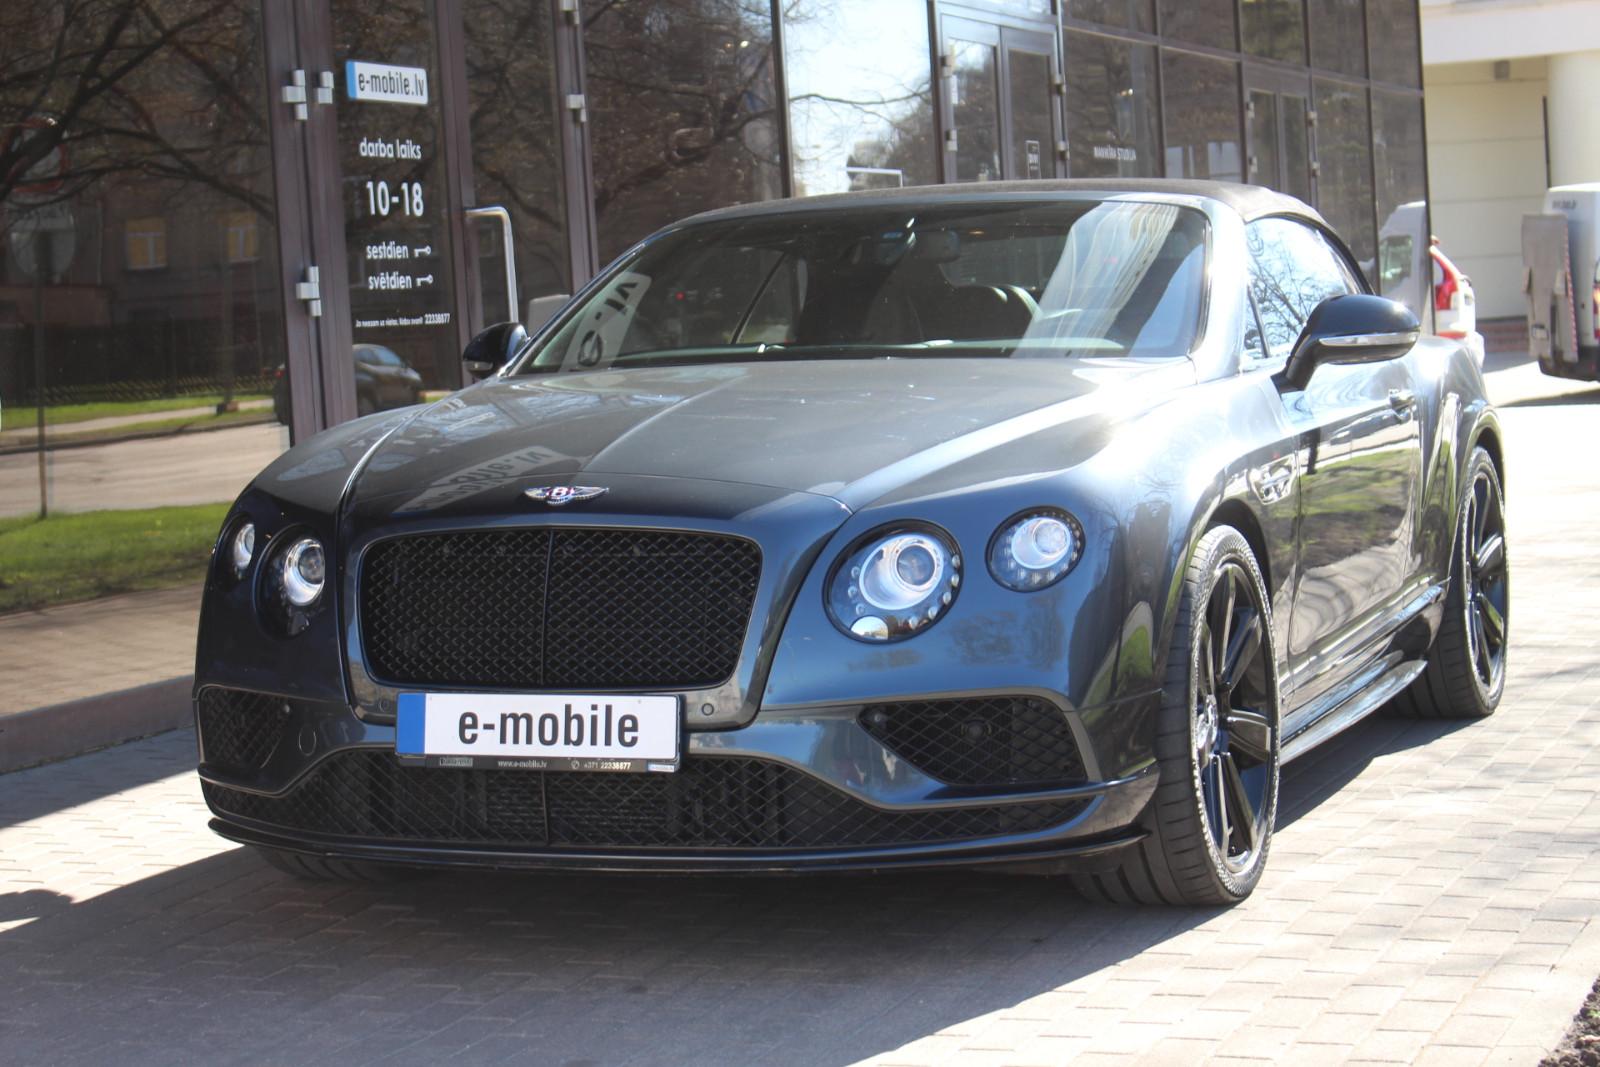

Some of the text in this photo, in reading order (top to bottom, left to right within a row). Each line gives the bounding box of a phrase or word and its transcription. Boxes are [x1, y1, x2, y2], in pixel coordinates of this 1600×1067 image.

[358, 71, 425, 97] e-mobile.lv
[359, 136, 422, 160] darba laiks
[366, 181, 424, 217] 10-18
[366, 241, 409, 259] sestdien
[368, 271, 413, 290] svētdien
[458, 703, 639, 748] e-mobile
[583, 761, 599, 770] +371
